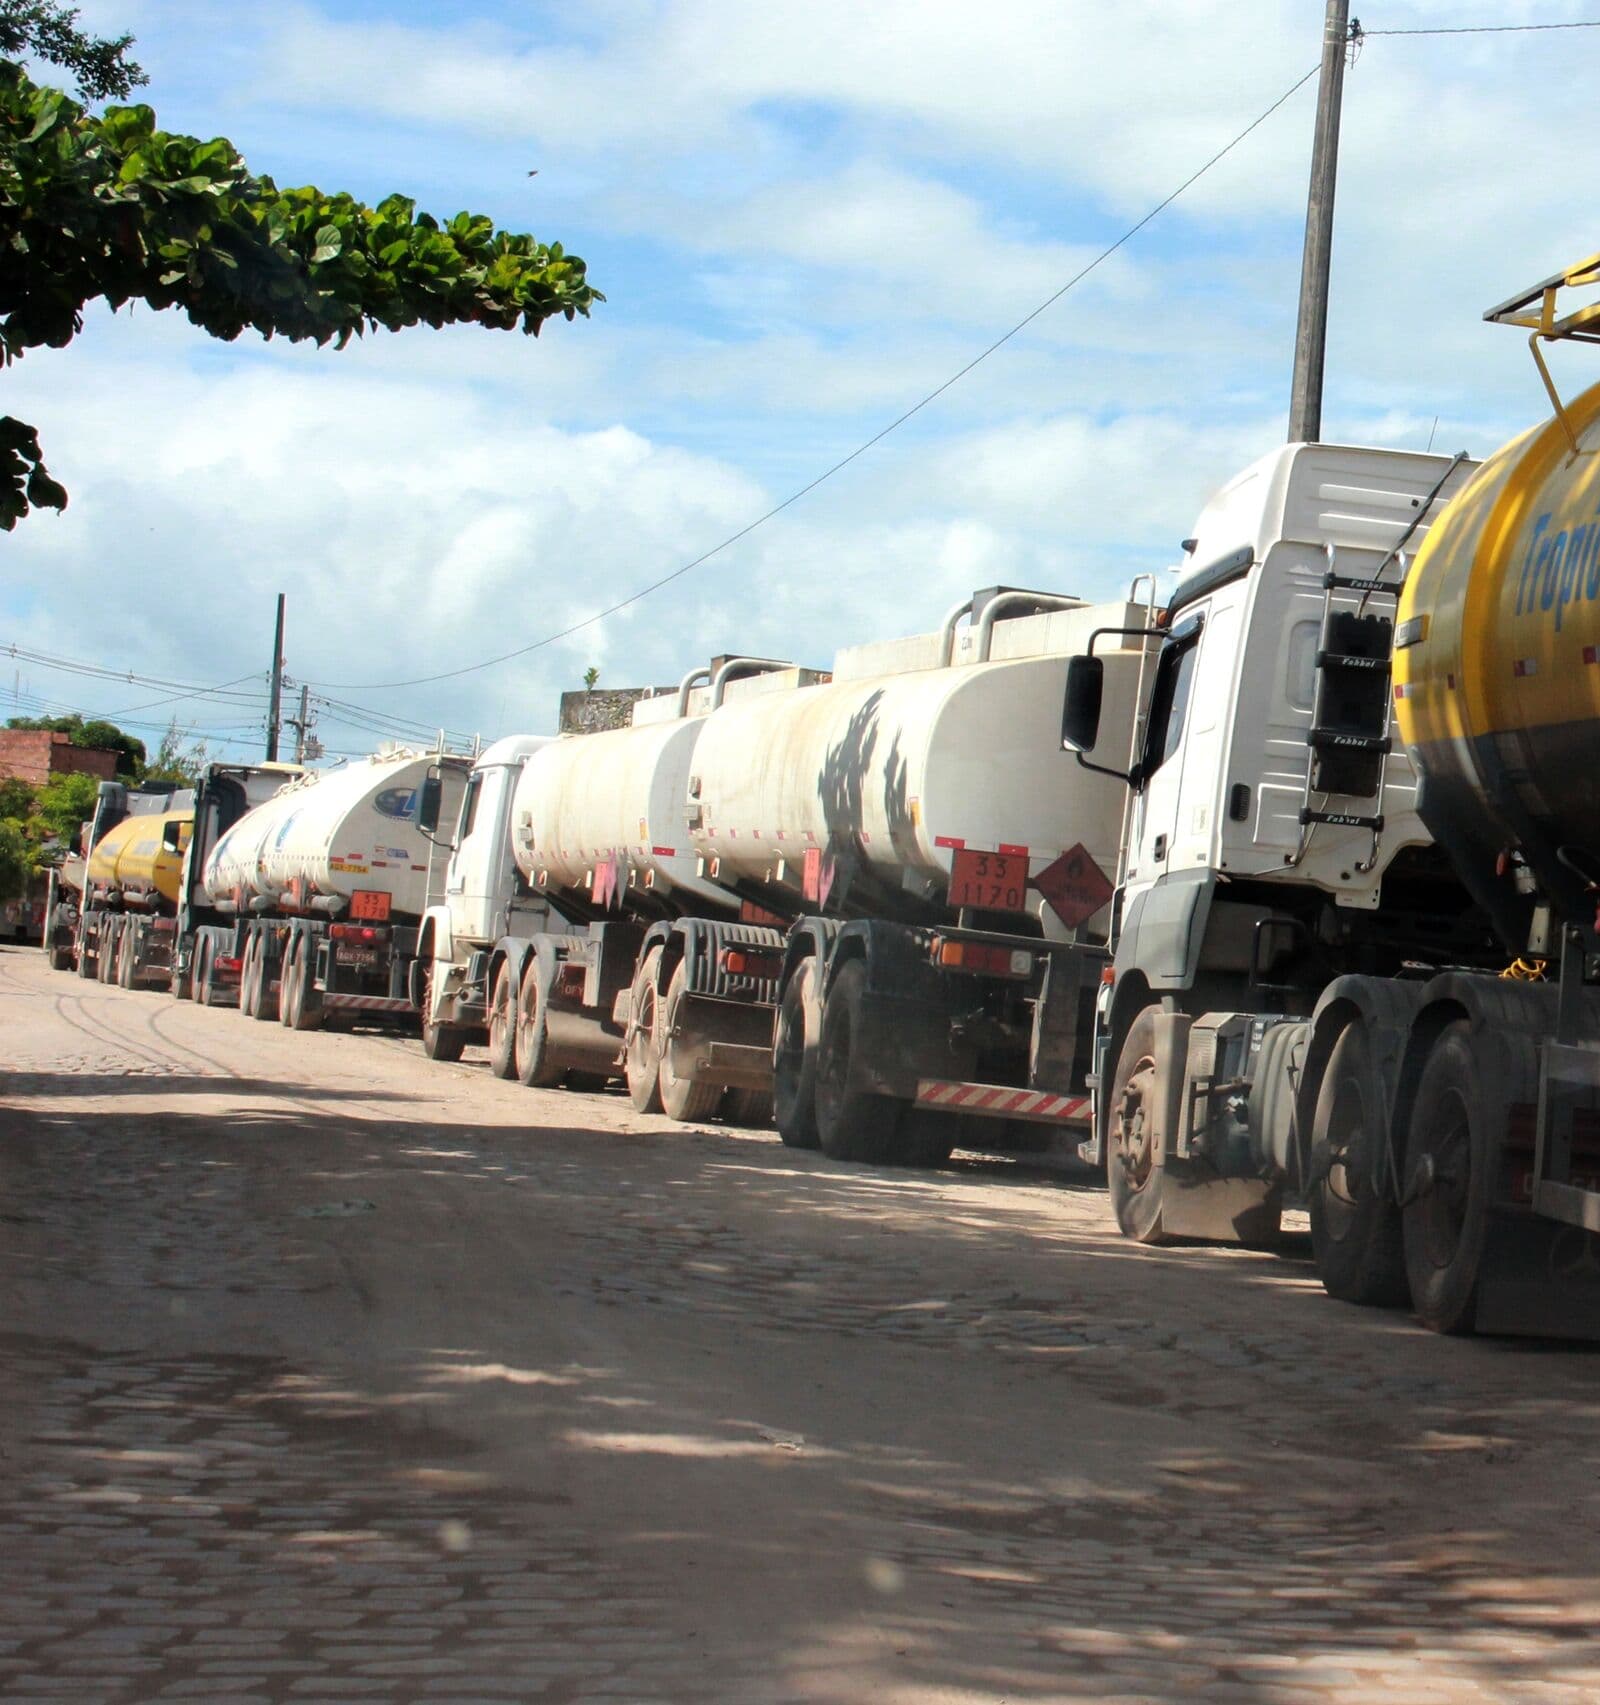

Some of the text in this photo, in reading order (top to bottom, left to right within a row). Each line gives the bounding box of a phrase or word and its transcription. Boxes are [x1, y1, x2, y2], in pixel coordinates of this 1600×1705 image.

[975, 855, 1007, 879] 33
[364, 894, 379, 905] 33
[961, 882, 1018, 908] 1170
[355, 905, 387, 918] 1170
